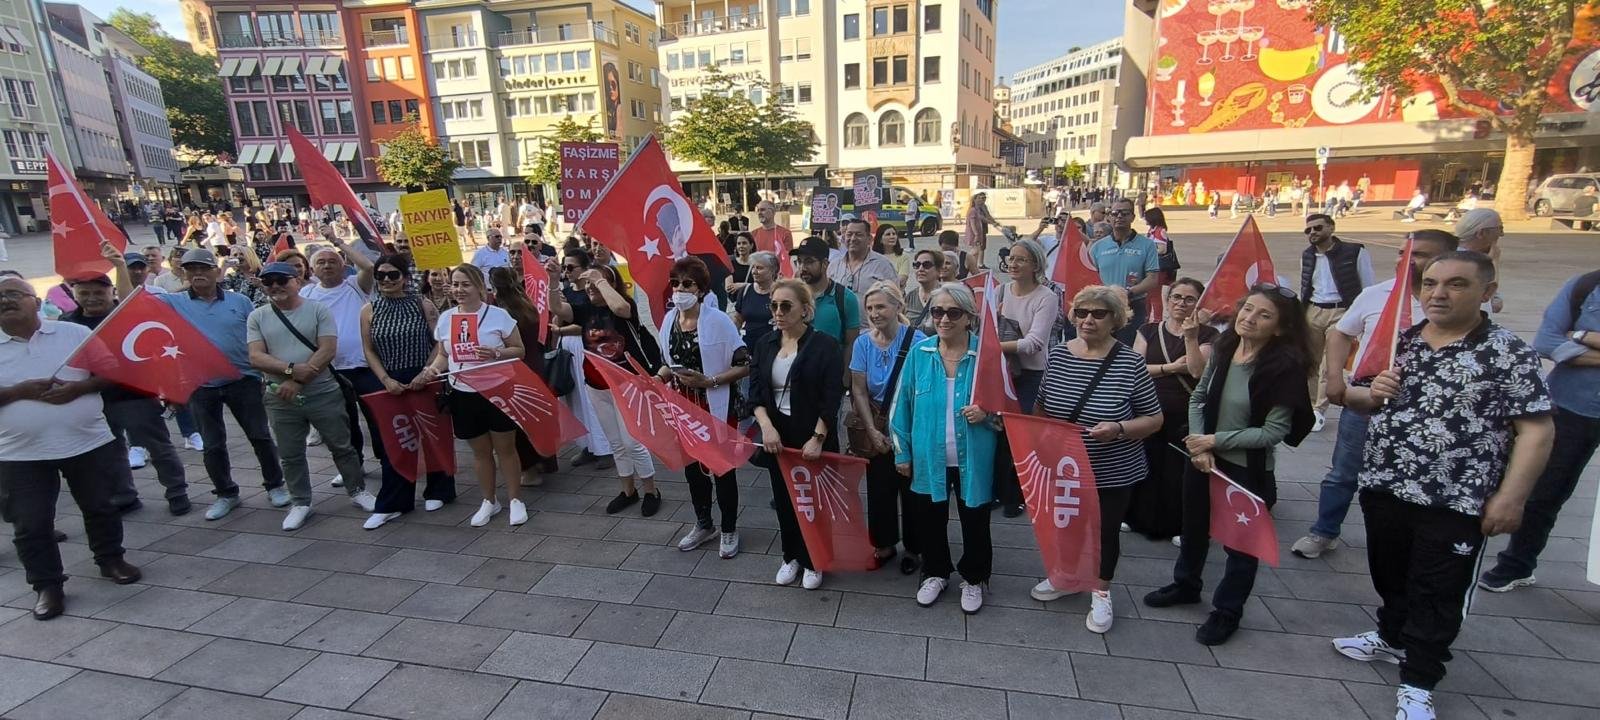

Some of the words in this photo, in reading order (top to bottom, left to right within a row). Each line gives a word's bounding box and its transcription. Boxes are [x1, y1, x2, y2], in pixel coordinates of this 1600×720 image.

[563, 145, 617, 160] FAŞİZME
[392, 414, 420, 452] CHP
[790, 465, 815, 522] CHP
